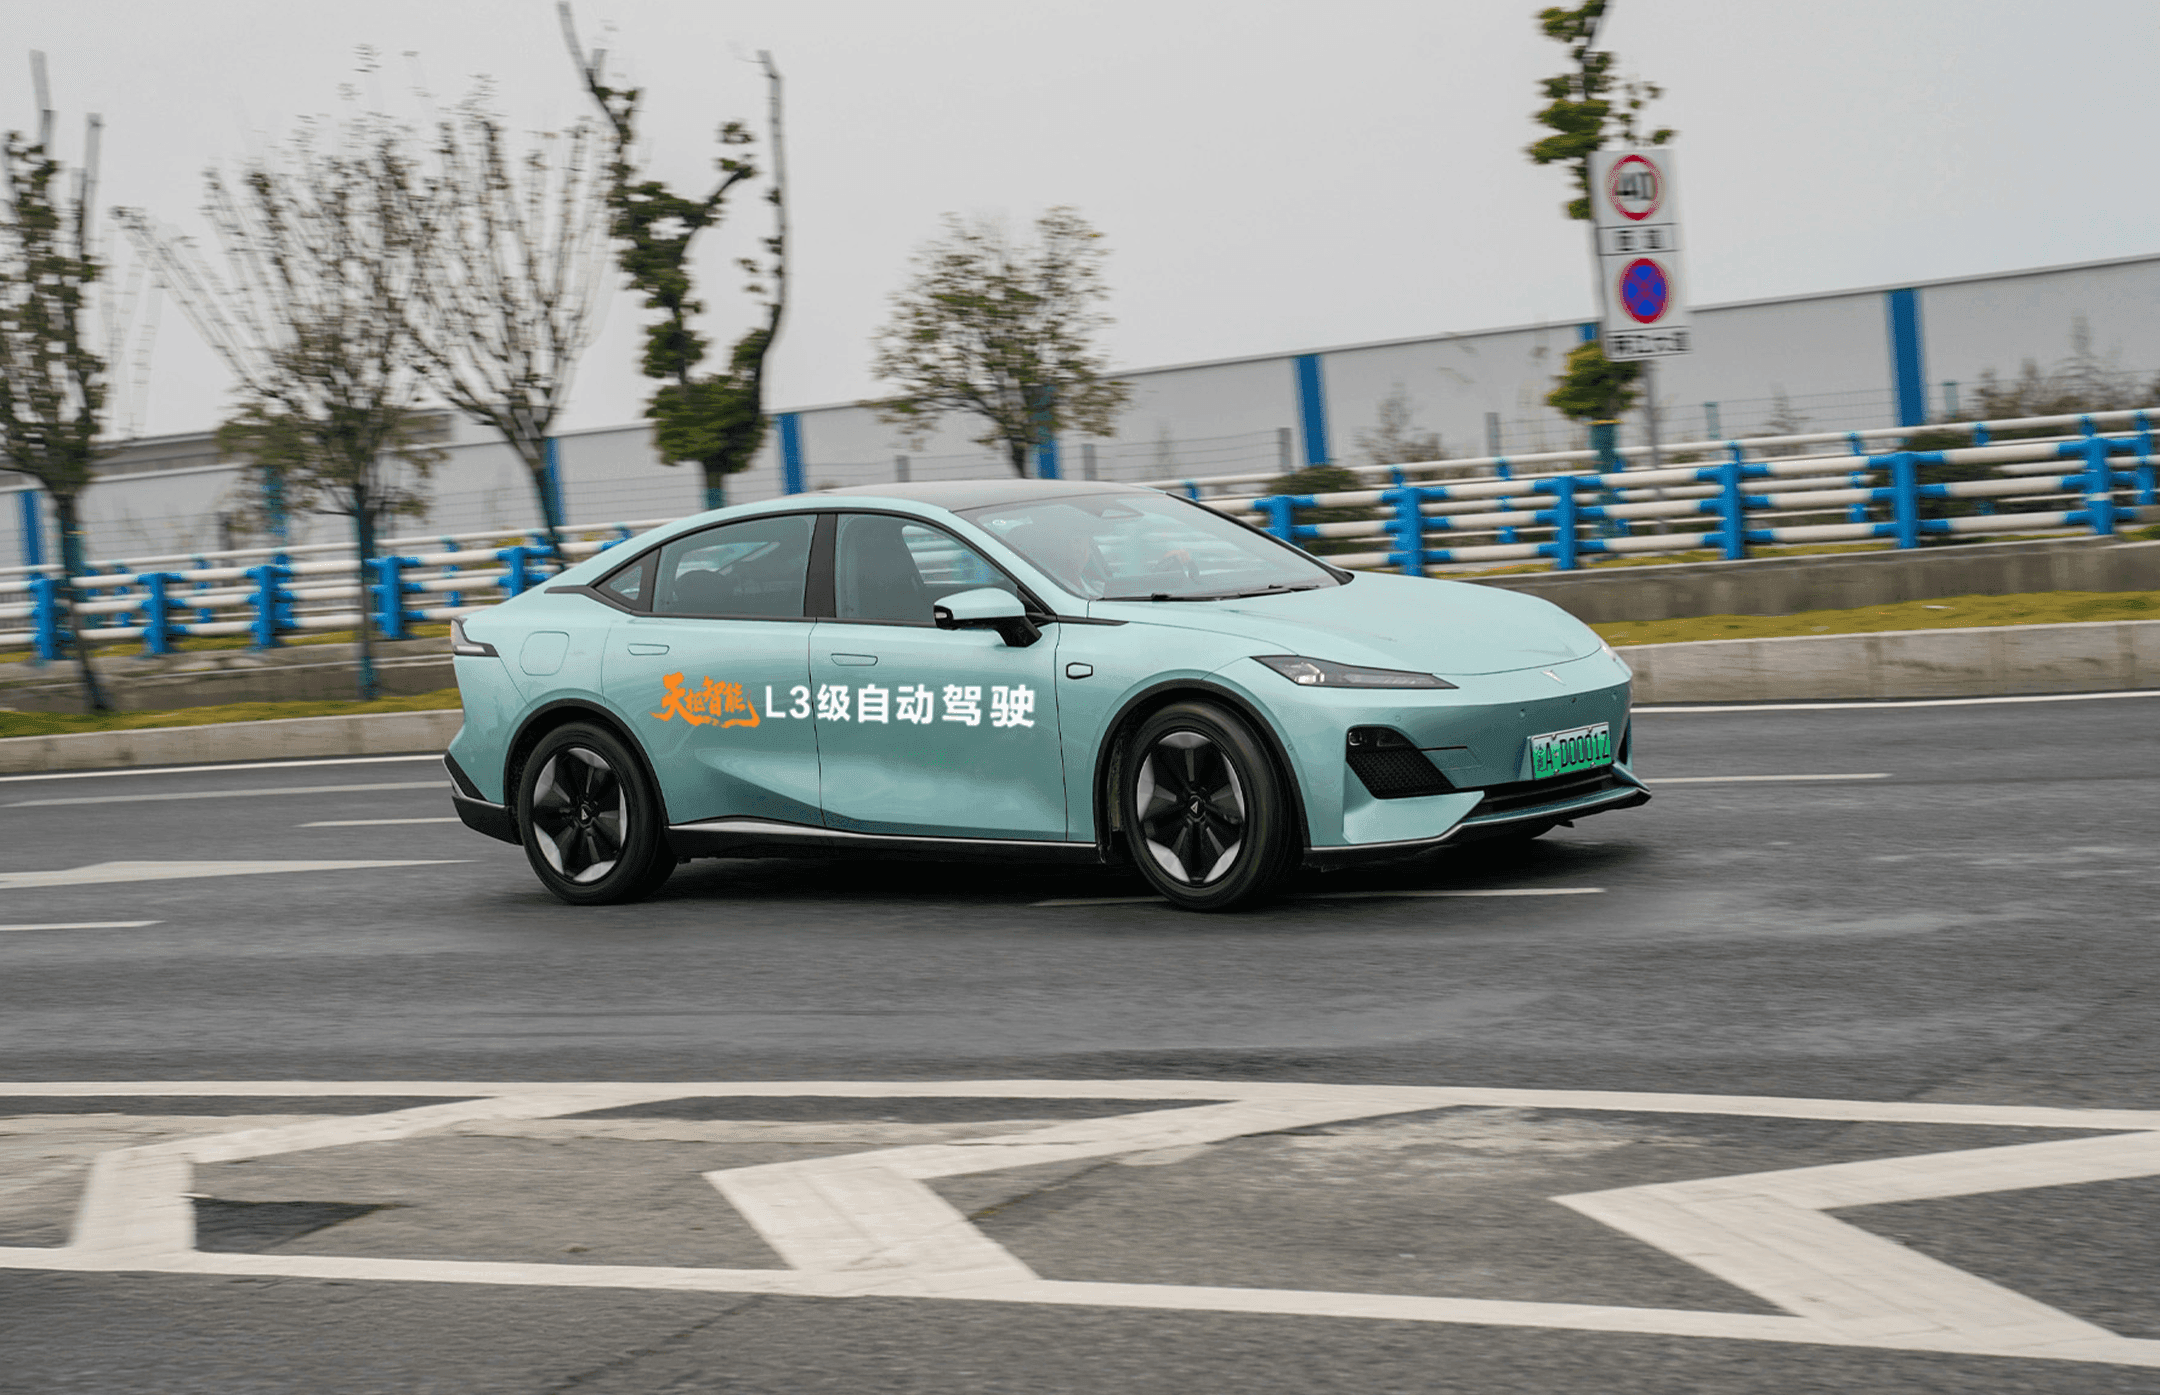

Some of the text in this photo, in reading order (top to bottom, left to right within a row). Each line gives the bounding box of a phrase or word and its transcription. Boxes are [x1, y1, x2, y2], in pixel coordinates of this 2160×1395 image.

[765, 683, 1035, 728] L3级自动驾驶
